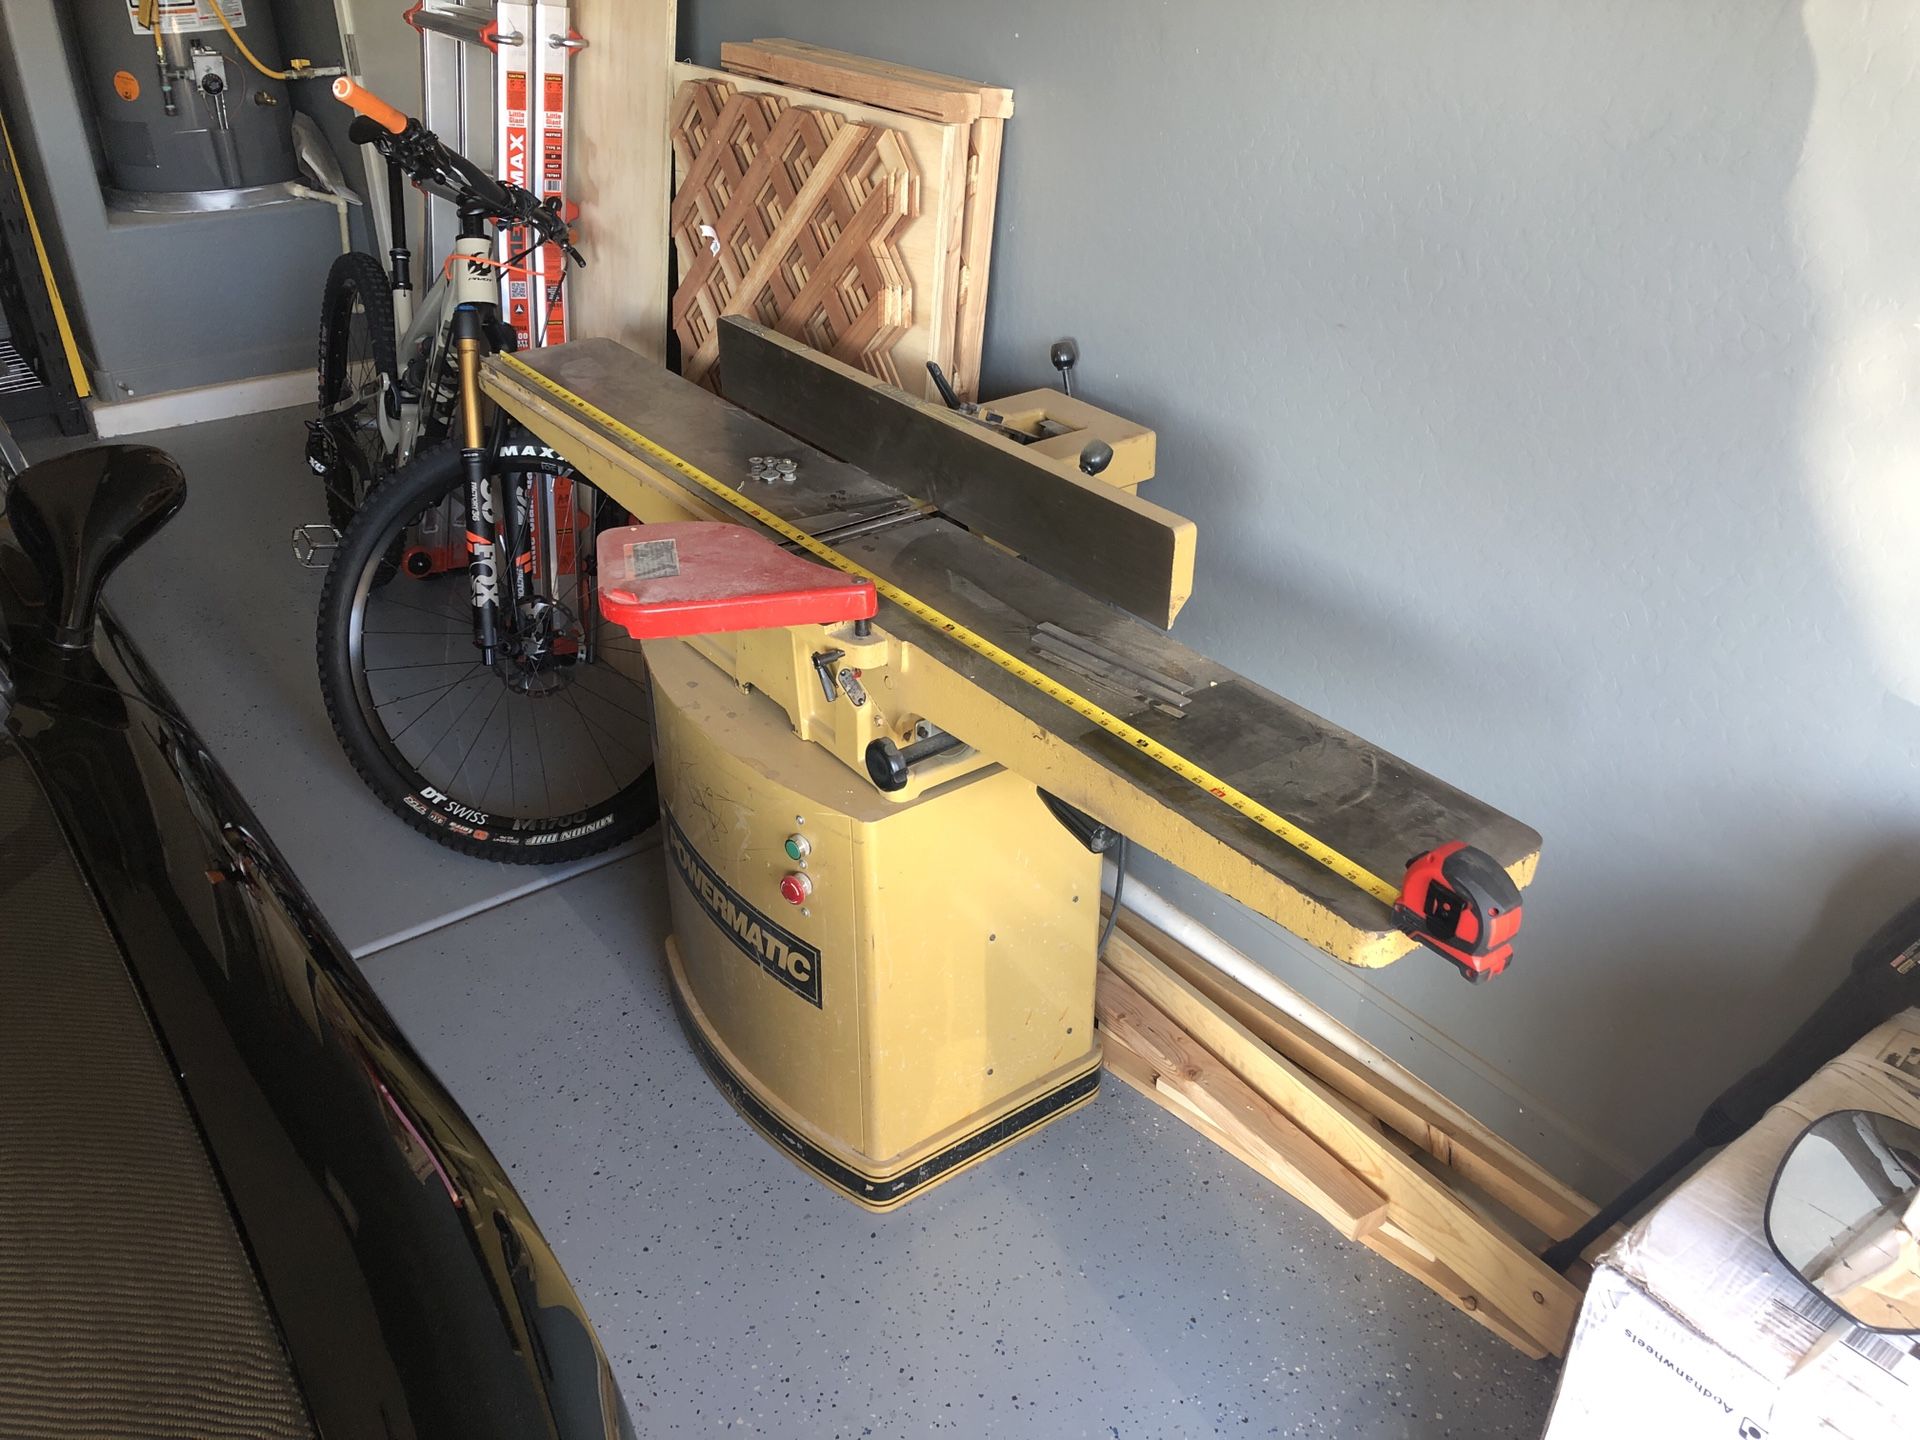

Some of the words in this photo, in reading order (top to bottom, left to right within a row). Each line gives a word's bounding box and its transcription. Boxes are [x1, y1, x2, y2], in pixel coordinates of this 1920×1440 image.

[471, 481, 480, 510] FACTORY
[469, 543, 500, 608] FOX
[420, 786, 448, 804] DT
[444, 801, 489, 825] SWISS
[560, 813, 614, 840] MINION
[670, 827, 812, 982] POWERMATIC
[1624, 1328, 1734, 1414] Aodhanwheels
